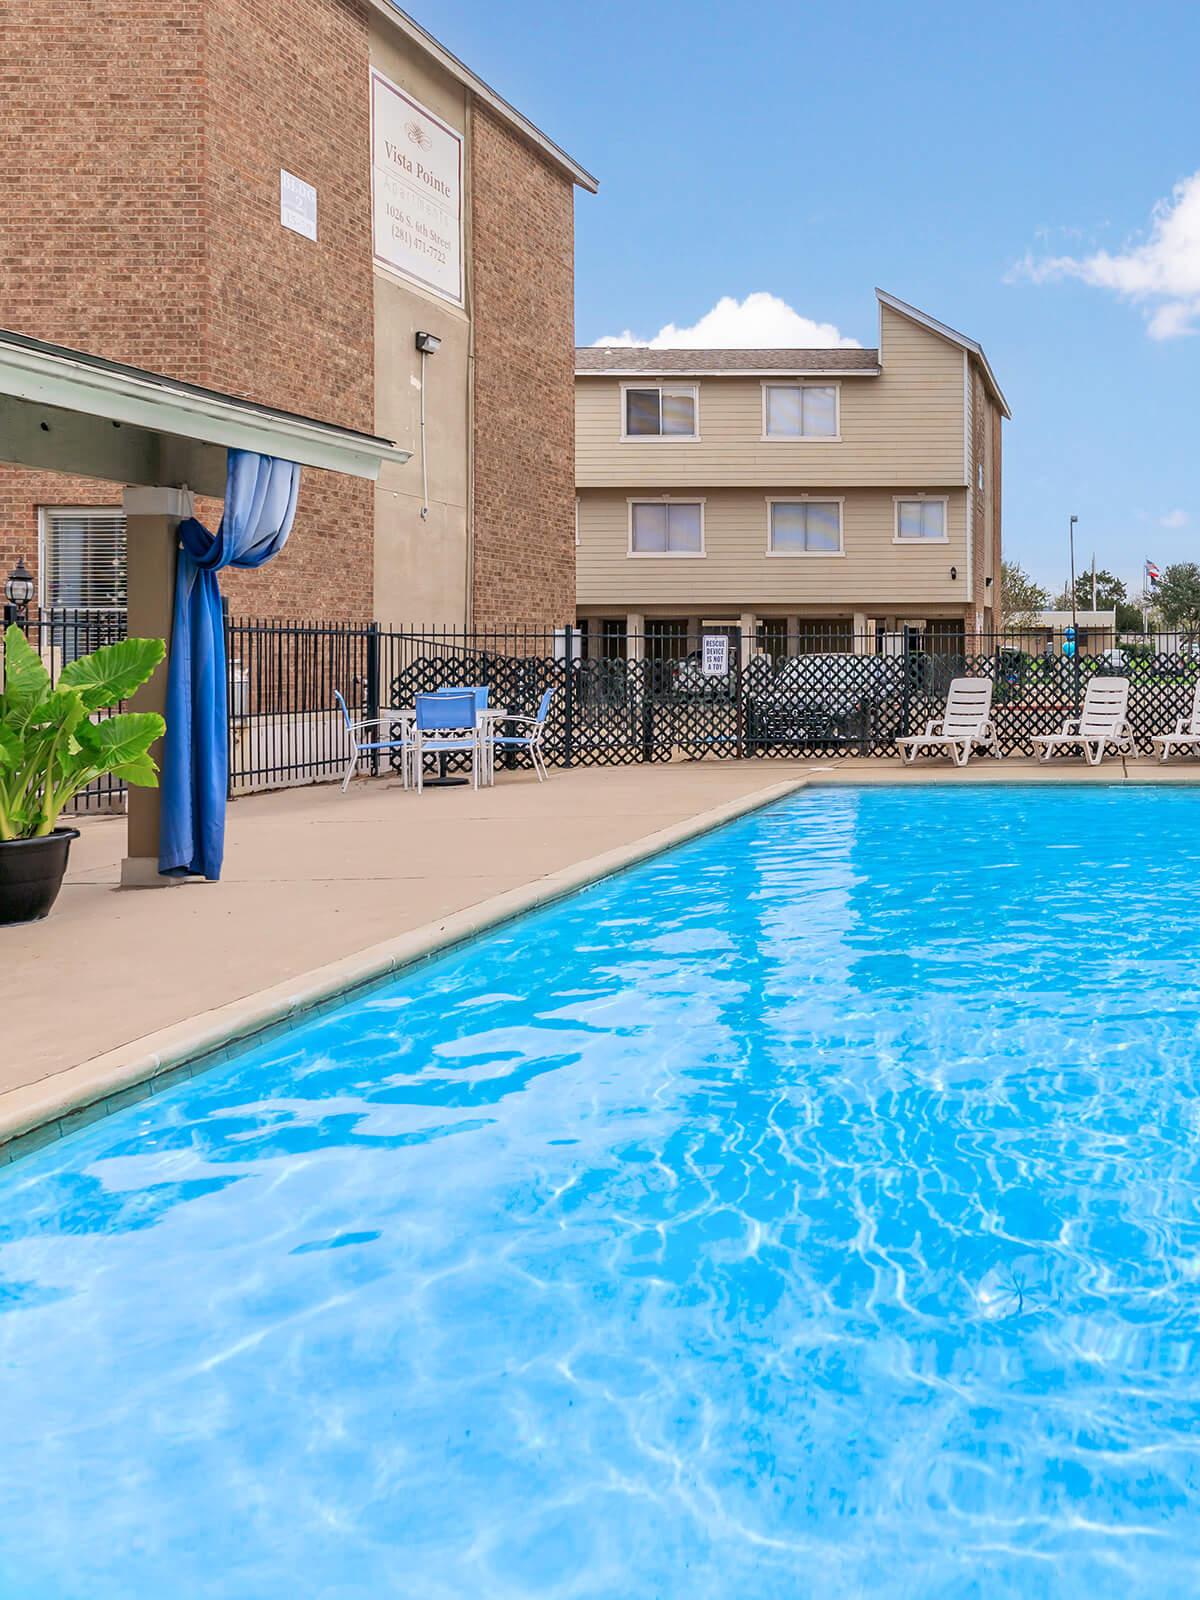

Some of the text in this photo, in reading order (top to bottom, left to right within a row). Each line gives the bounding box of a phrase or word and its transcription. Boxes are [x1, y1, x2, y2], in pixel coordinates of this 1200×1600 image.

[384, 140, 451, 198] Vista Pointe
[385, 203, 404, 224] 1026
[430, 229, 451, 250] Street
[391, 224, 412, 249] (281)
